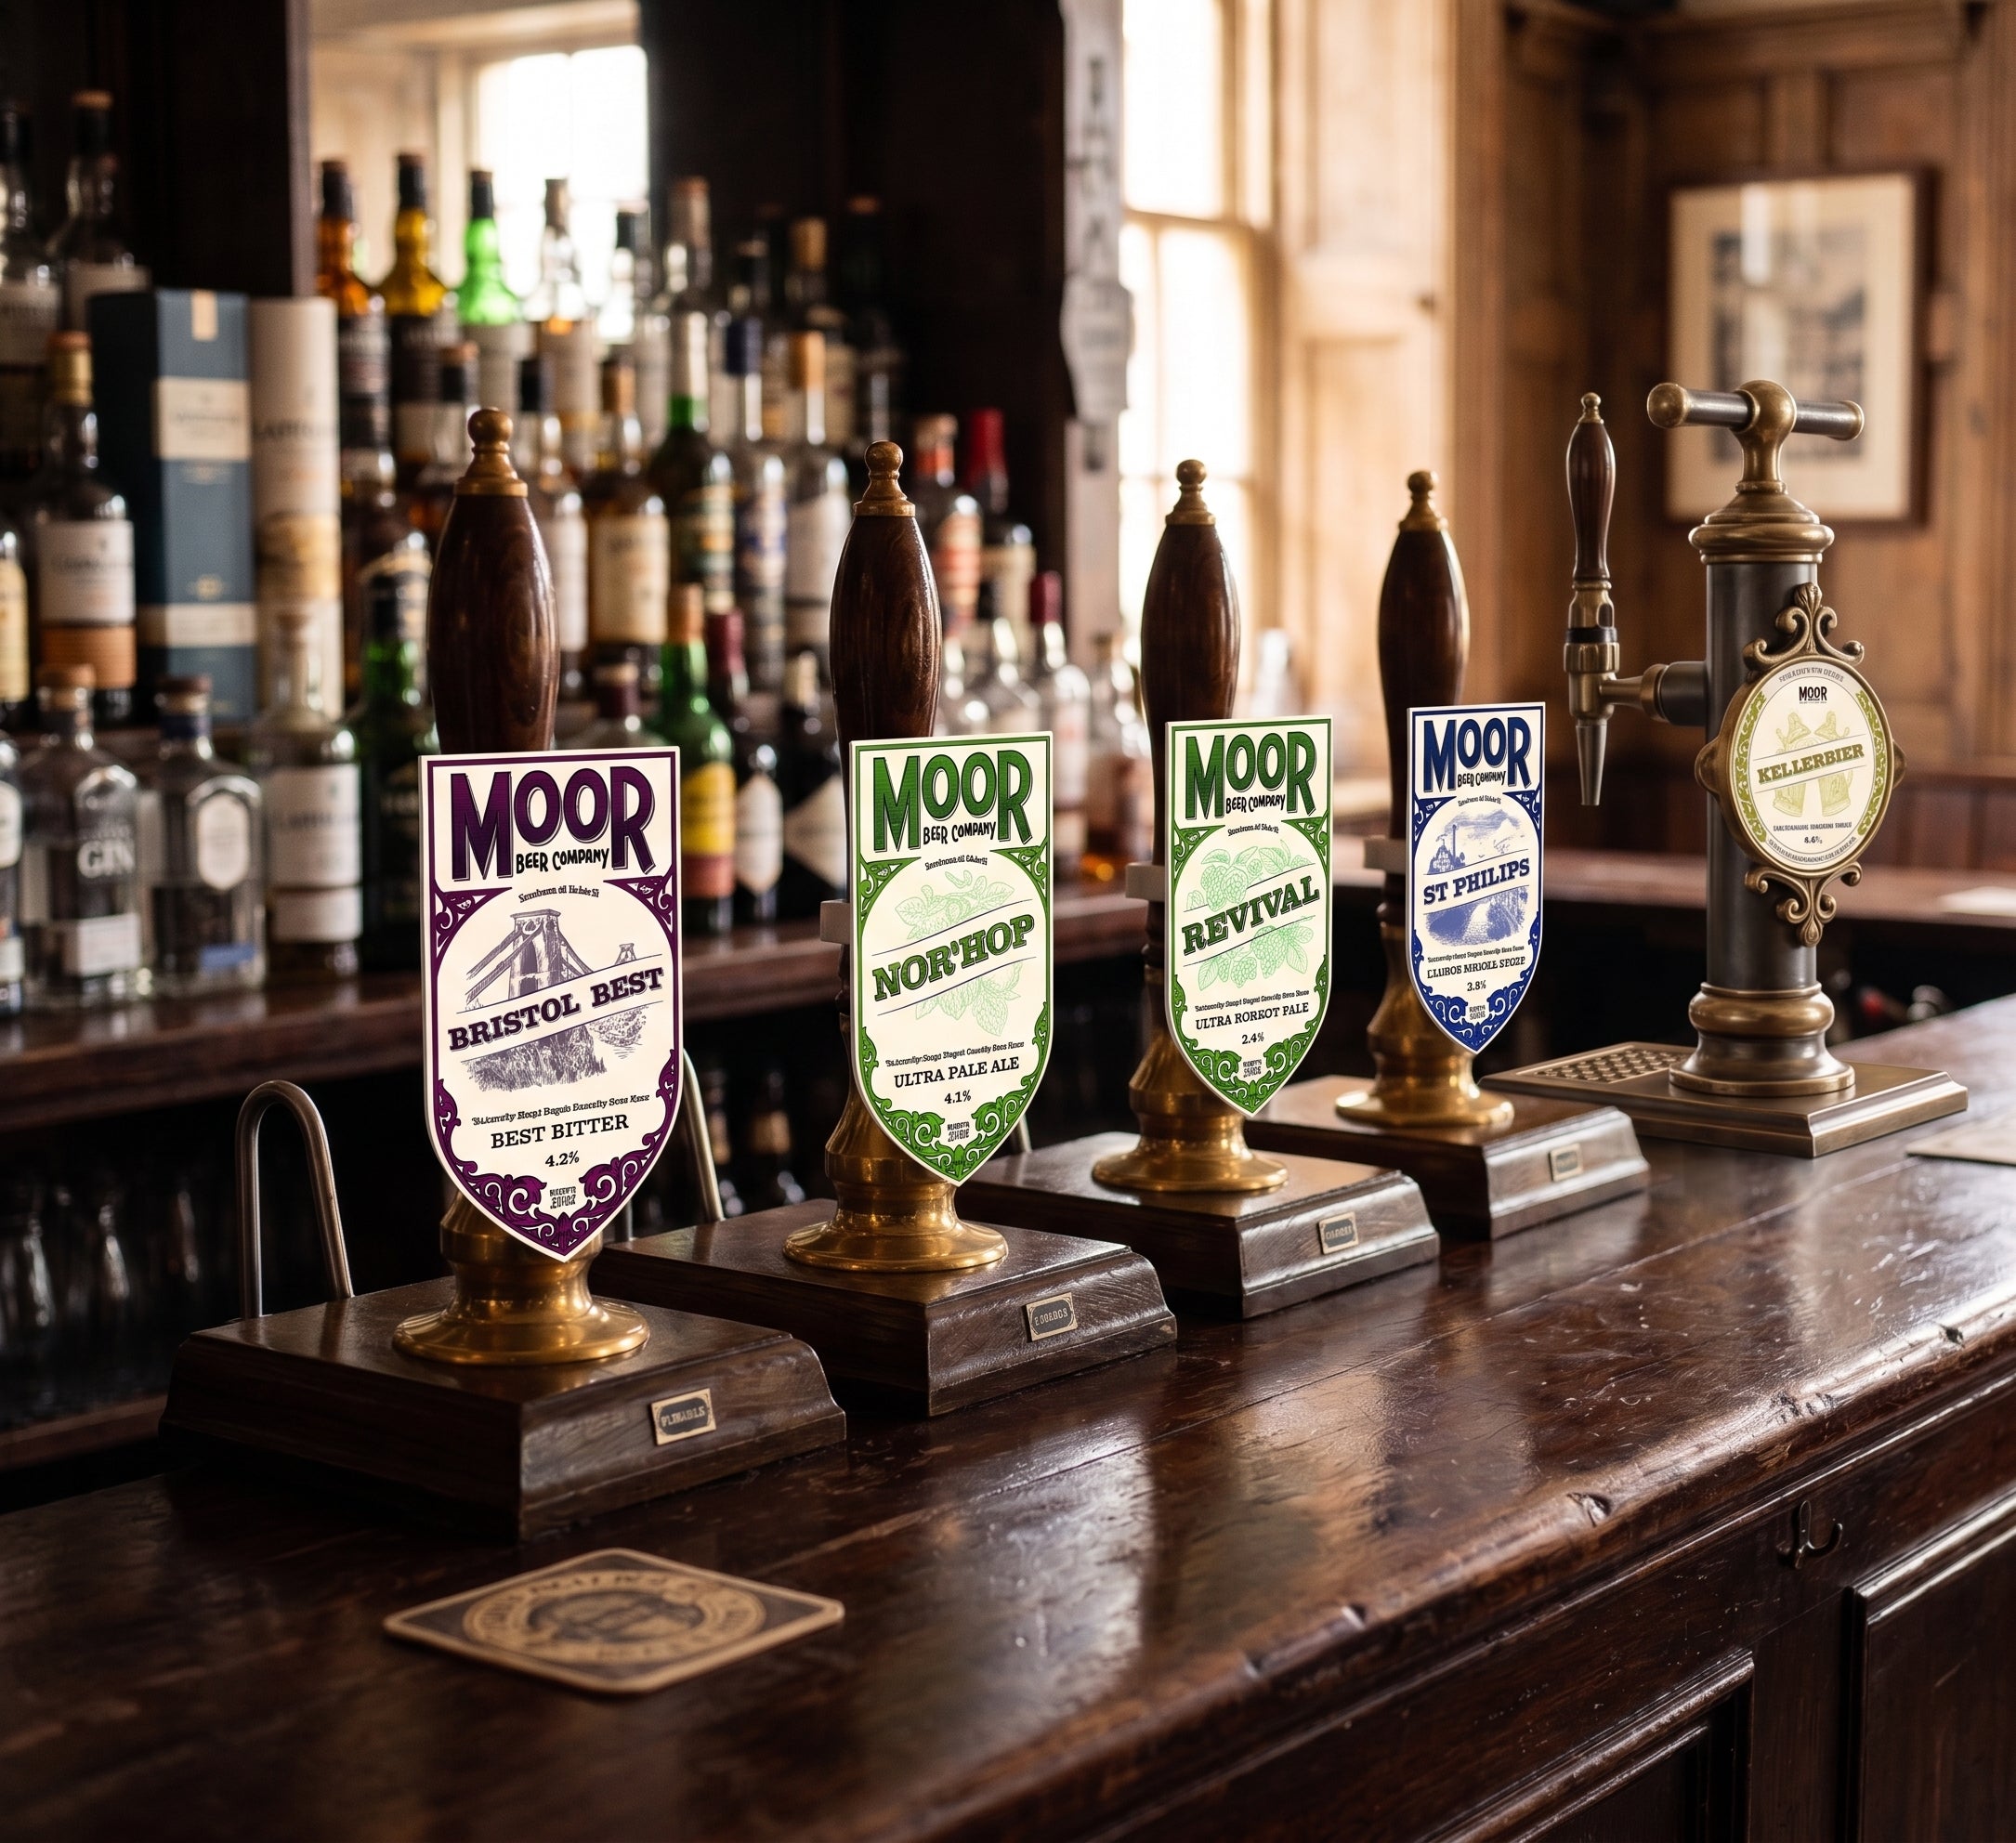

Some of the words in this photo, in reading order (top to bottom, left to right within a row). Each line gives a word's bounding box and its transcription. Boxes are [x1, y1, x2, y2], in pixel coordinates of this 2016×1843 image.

[1799, 686, 1827, 701] MOOR
[1423, 716, 1532, 793] MOOR
[1757, 743, 1865, 785] KELLERBIER
[1185, 731, 1316, 820] MOOR
[873, 750, 1033, 853] MOOR
[1225, 796, 1247, 814] BEER
[451, 766, 656, 881] MOOR
[951, 821, 997, 843] COMPANY
[516, 852, 549, 874] BEER
[552, 847, 610, 871] COMPANY
[1423, 882, 1449, 906] ST
[1452, 857, 1530, 898] PHILIPS
[1182, 875, 1320, 956] REVIVAL
[871, 913, 1035, 1002] NOR'HOP
[448, 993, 582, 1052] BRISTOL
[590, 967, 664, 1008] BEST
[1195, 1014, 1233, 1030] ULTRA
[1282, 1002, 1309, 1016] PALE
[1241, 1032, 1264, 1045] 2.4%
[894, 1069, 945, 1089] ULTRA
[948, 1061, 988, 1080] PALE
[990, 1056, 1020, 1074] ALE
[944, 1090, 972, 1104] 4.1%
[491, 1126, 545, 1149] BEST
[551, 1114, 629, 1140] BITTER
[544, 1150, 580, 1168] 4.2%
